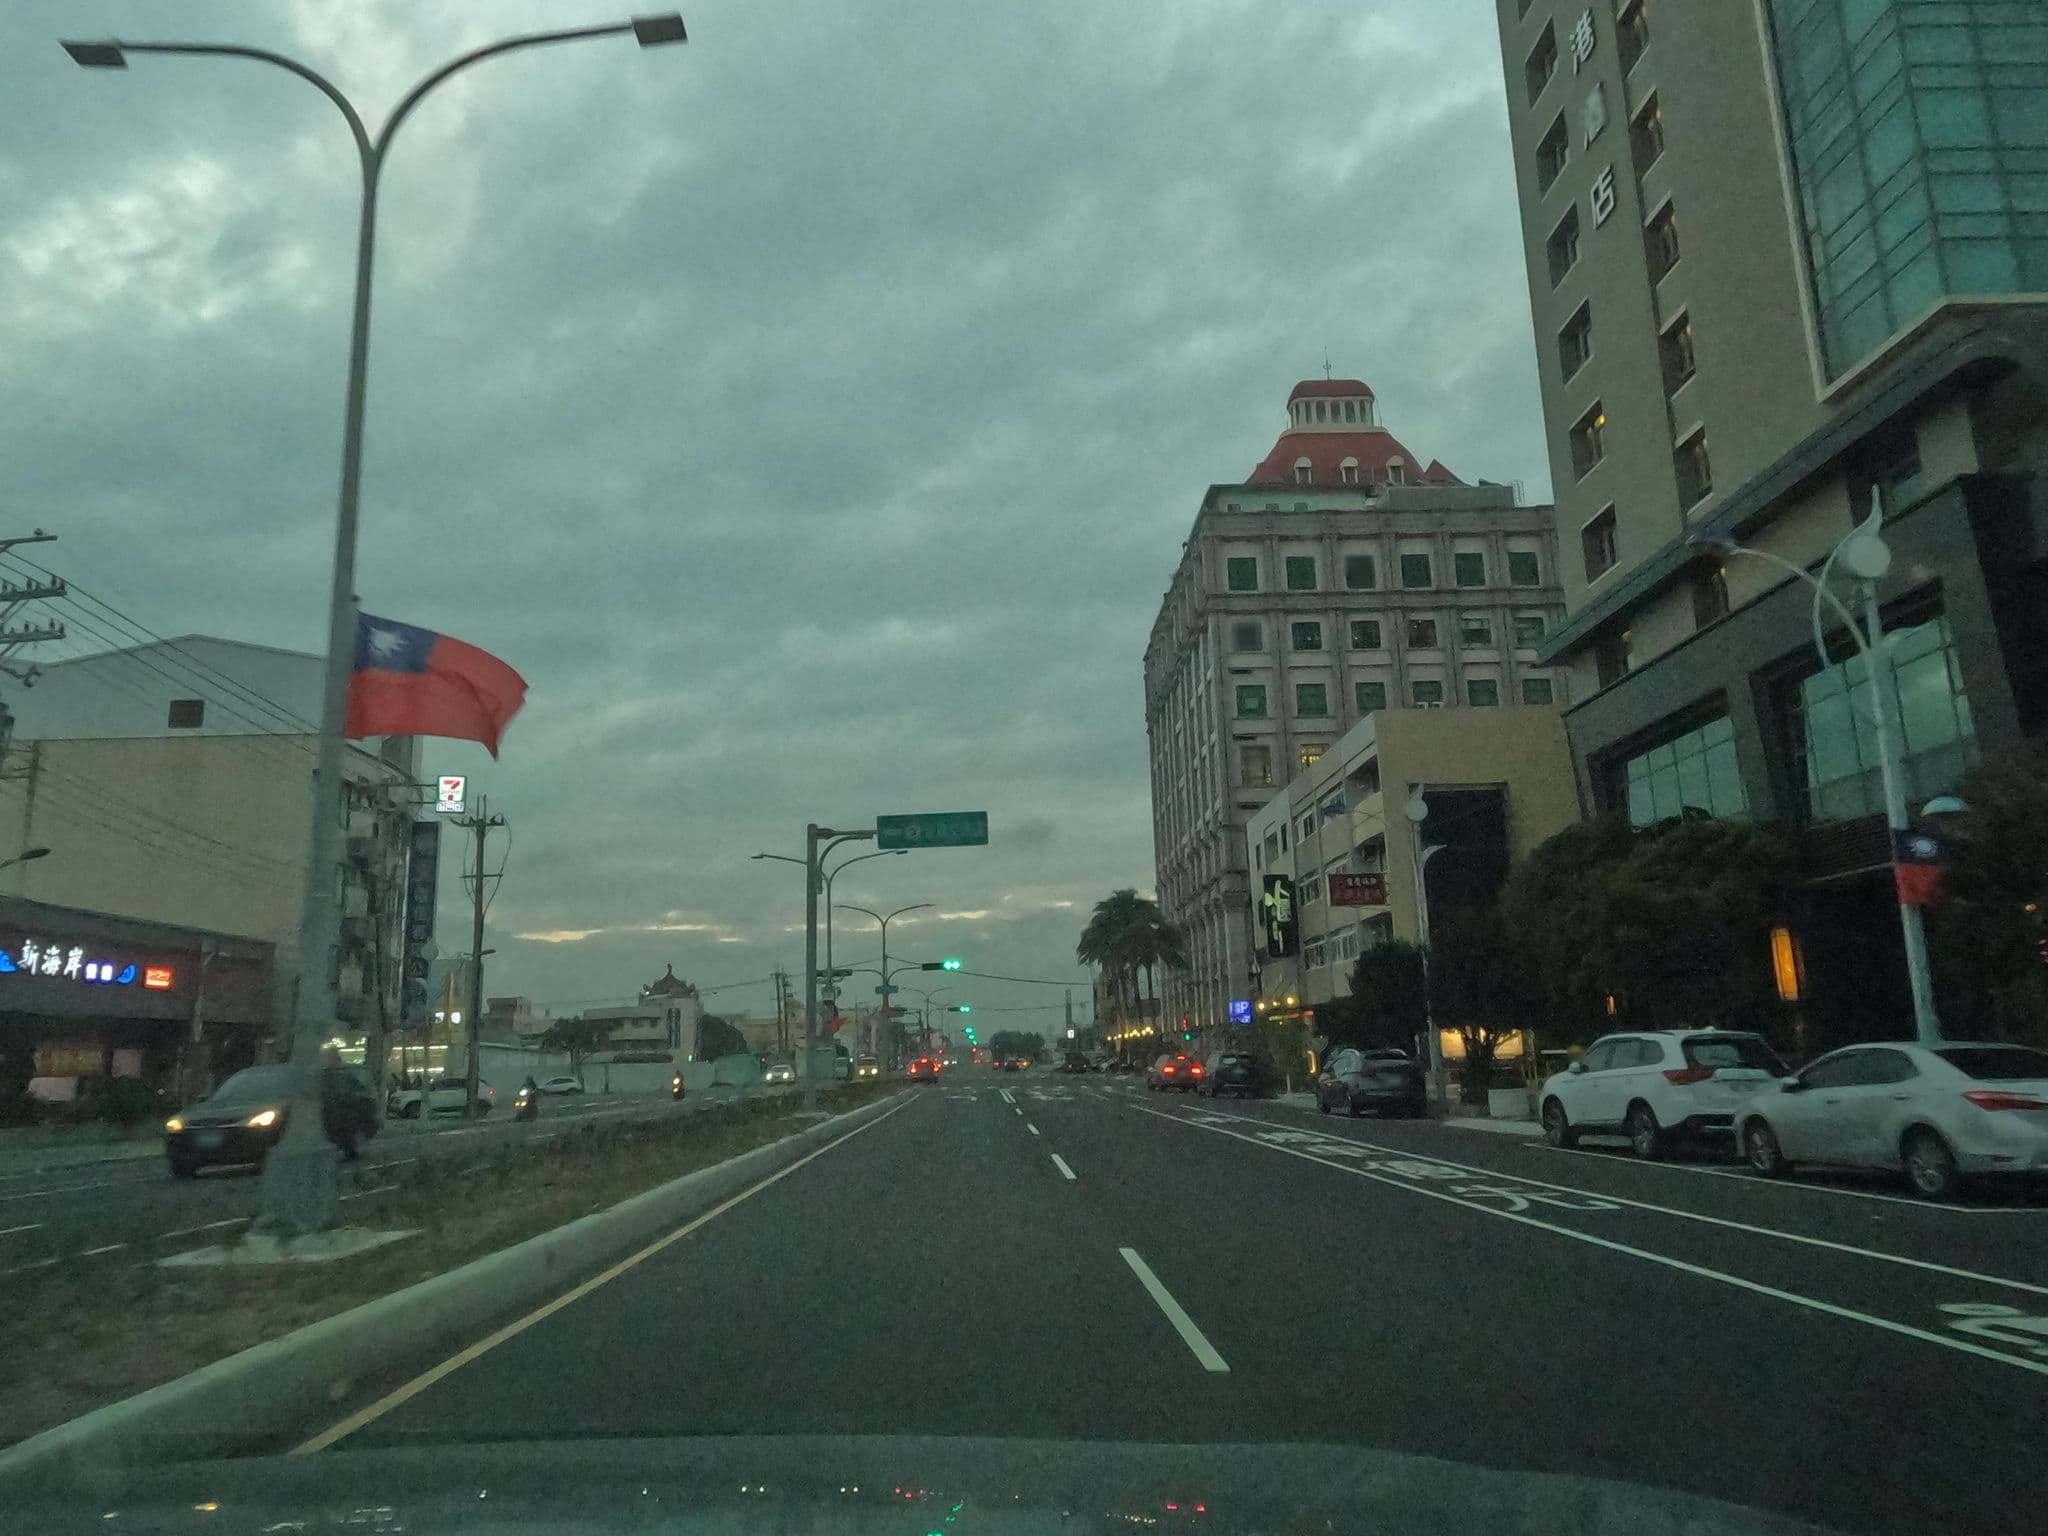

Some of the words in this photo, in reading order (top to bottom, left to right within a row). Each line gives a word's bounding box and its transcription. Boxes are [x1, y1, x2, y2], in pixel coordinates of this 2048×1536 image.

[1569, 8, 1615, 229] 港店
[17, 938, 84, 981] 新海岸
